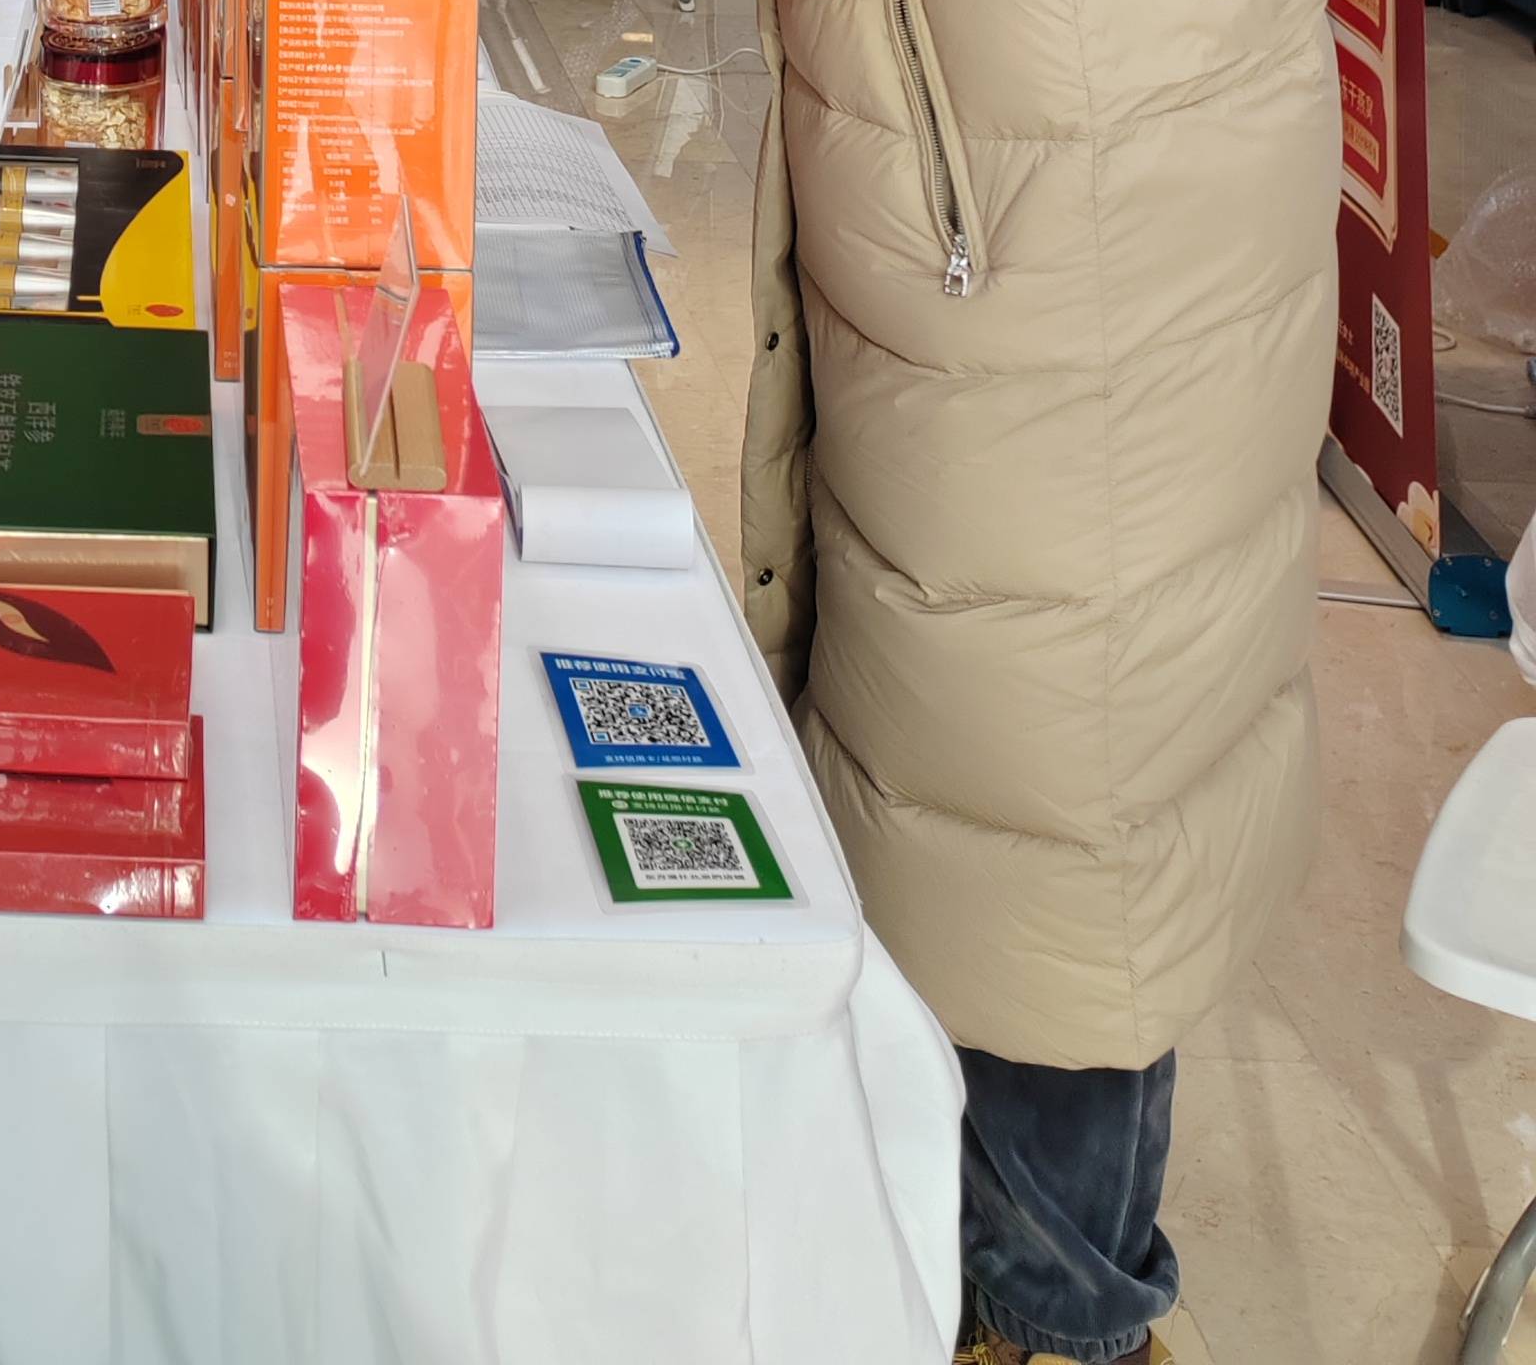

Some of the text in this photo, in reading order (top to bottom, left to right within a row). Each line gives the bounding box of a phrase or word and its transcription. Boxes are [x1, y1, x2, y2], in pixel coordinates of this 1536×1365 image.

[24, 401, 57, 444] 西洋参
[554, 657, 687, 681] 推荐使用支付宝
[598, 788, 729, 806] 推荐使用微信支付
